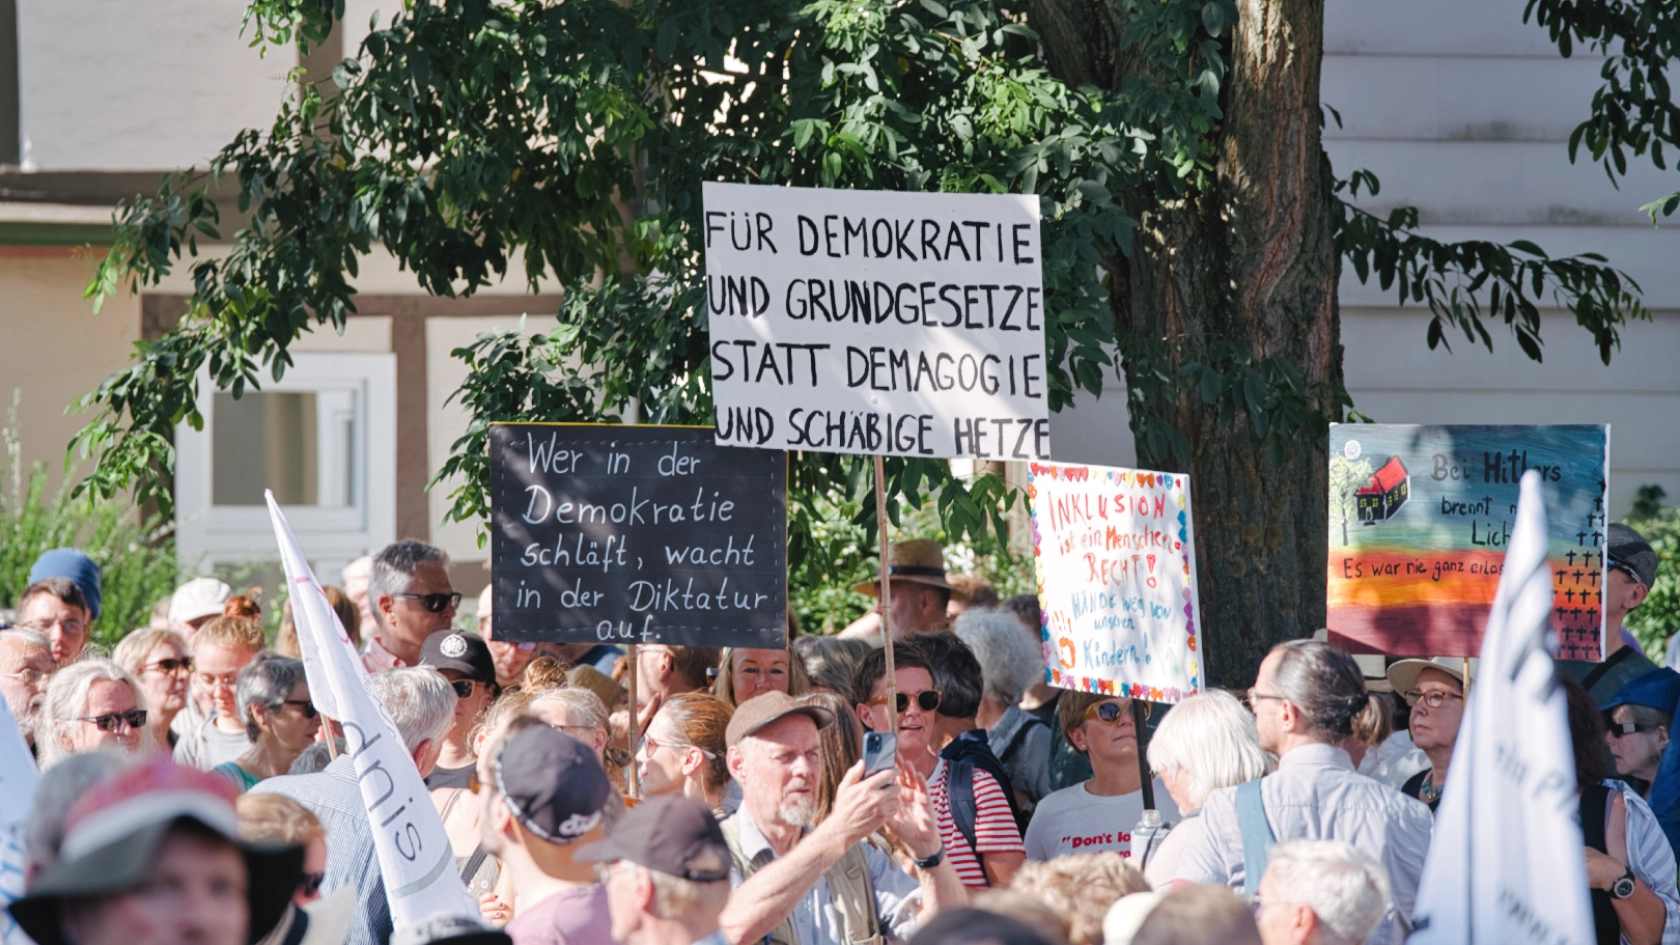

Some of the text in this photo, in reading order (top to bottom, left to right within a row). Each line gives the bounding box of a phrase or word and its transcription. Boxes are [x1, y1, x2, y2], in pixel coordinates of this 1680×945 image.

[705, 211, 1034, 265] FÜR DEMOKRATIE
[708, 274, 1042, 332] UND GRUNDGESETZE
[711, 340, 1042, 399] STATT DEMAGOGIE
[714, 405, 1050, 460] UND SCHÄBIGE HETZE
[527, 431, 700, 476] Wer in der
[1431, 449, 1562, 484] Bei Hitlrs
[522, 484, 735, 526] Demokratie
[1048, 490, 1165, 532] INKLUSION
[1441, 495, 1493, 515] brennt
[665, 534, 755, 565] wacht
[1057, 530, 1075, 556] ist
[1081, 526, 1102, 550] ein
[1472, 520, 1511, 546] Lich
[1083, 552, 1157, 588] RECHT!
[1343, 558, 1362, 579] Es
[1372, 559, 1401, 577] war
[1406, 557, 1427, 575] nie
[1432, 560, 1464, 582] ganz
[516, 577, 768, 611] in der Diktatur
[596, 614, 661, 642] auf.
